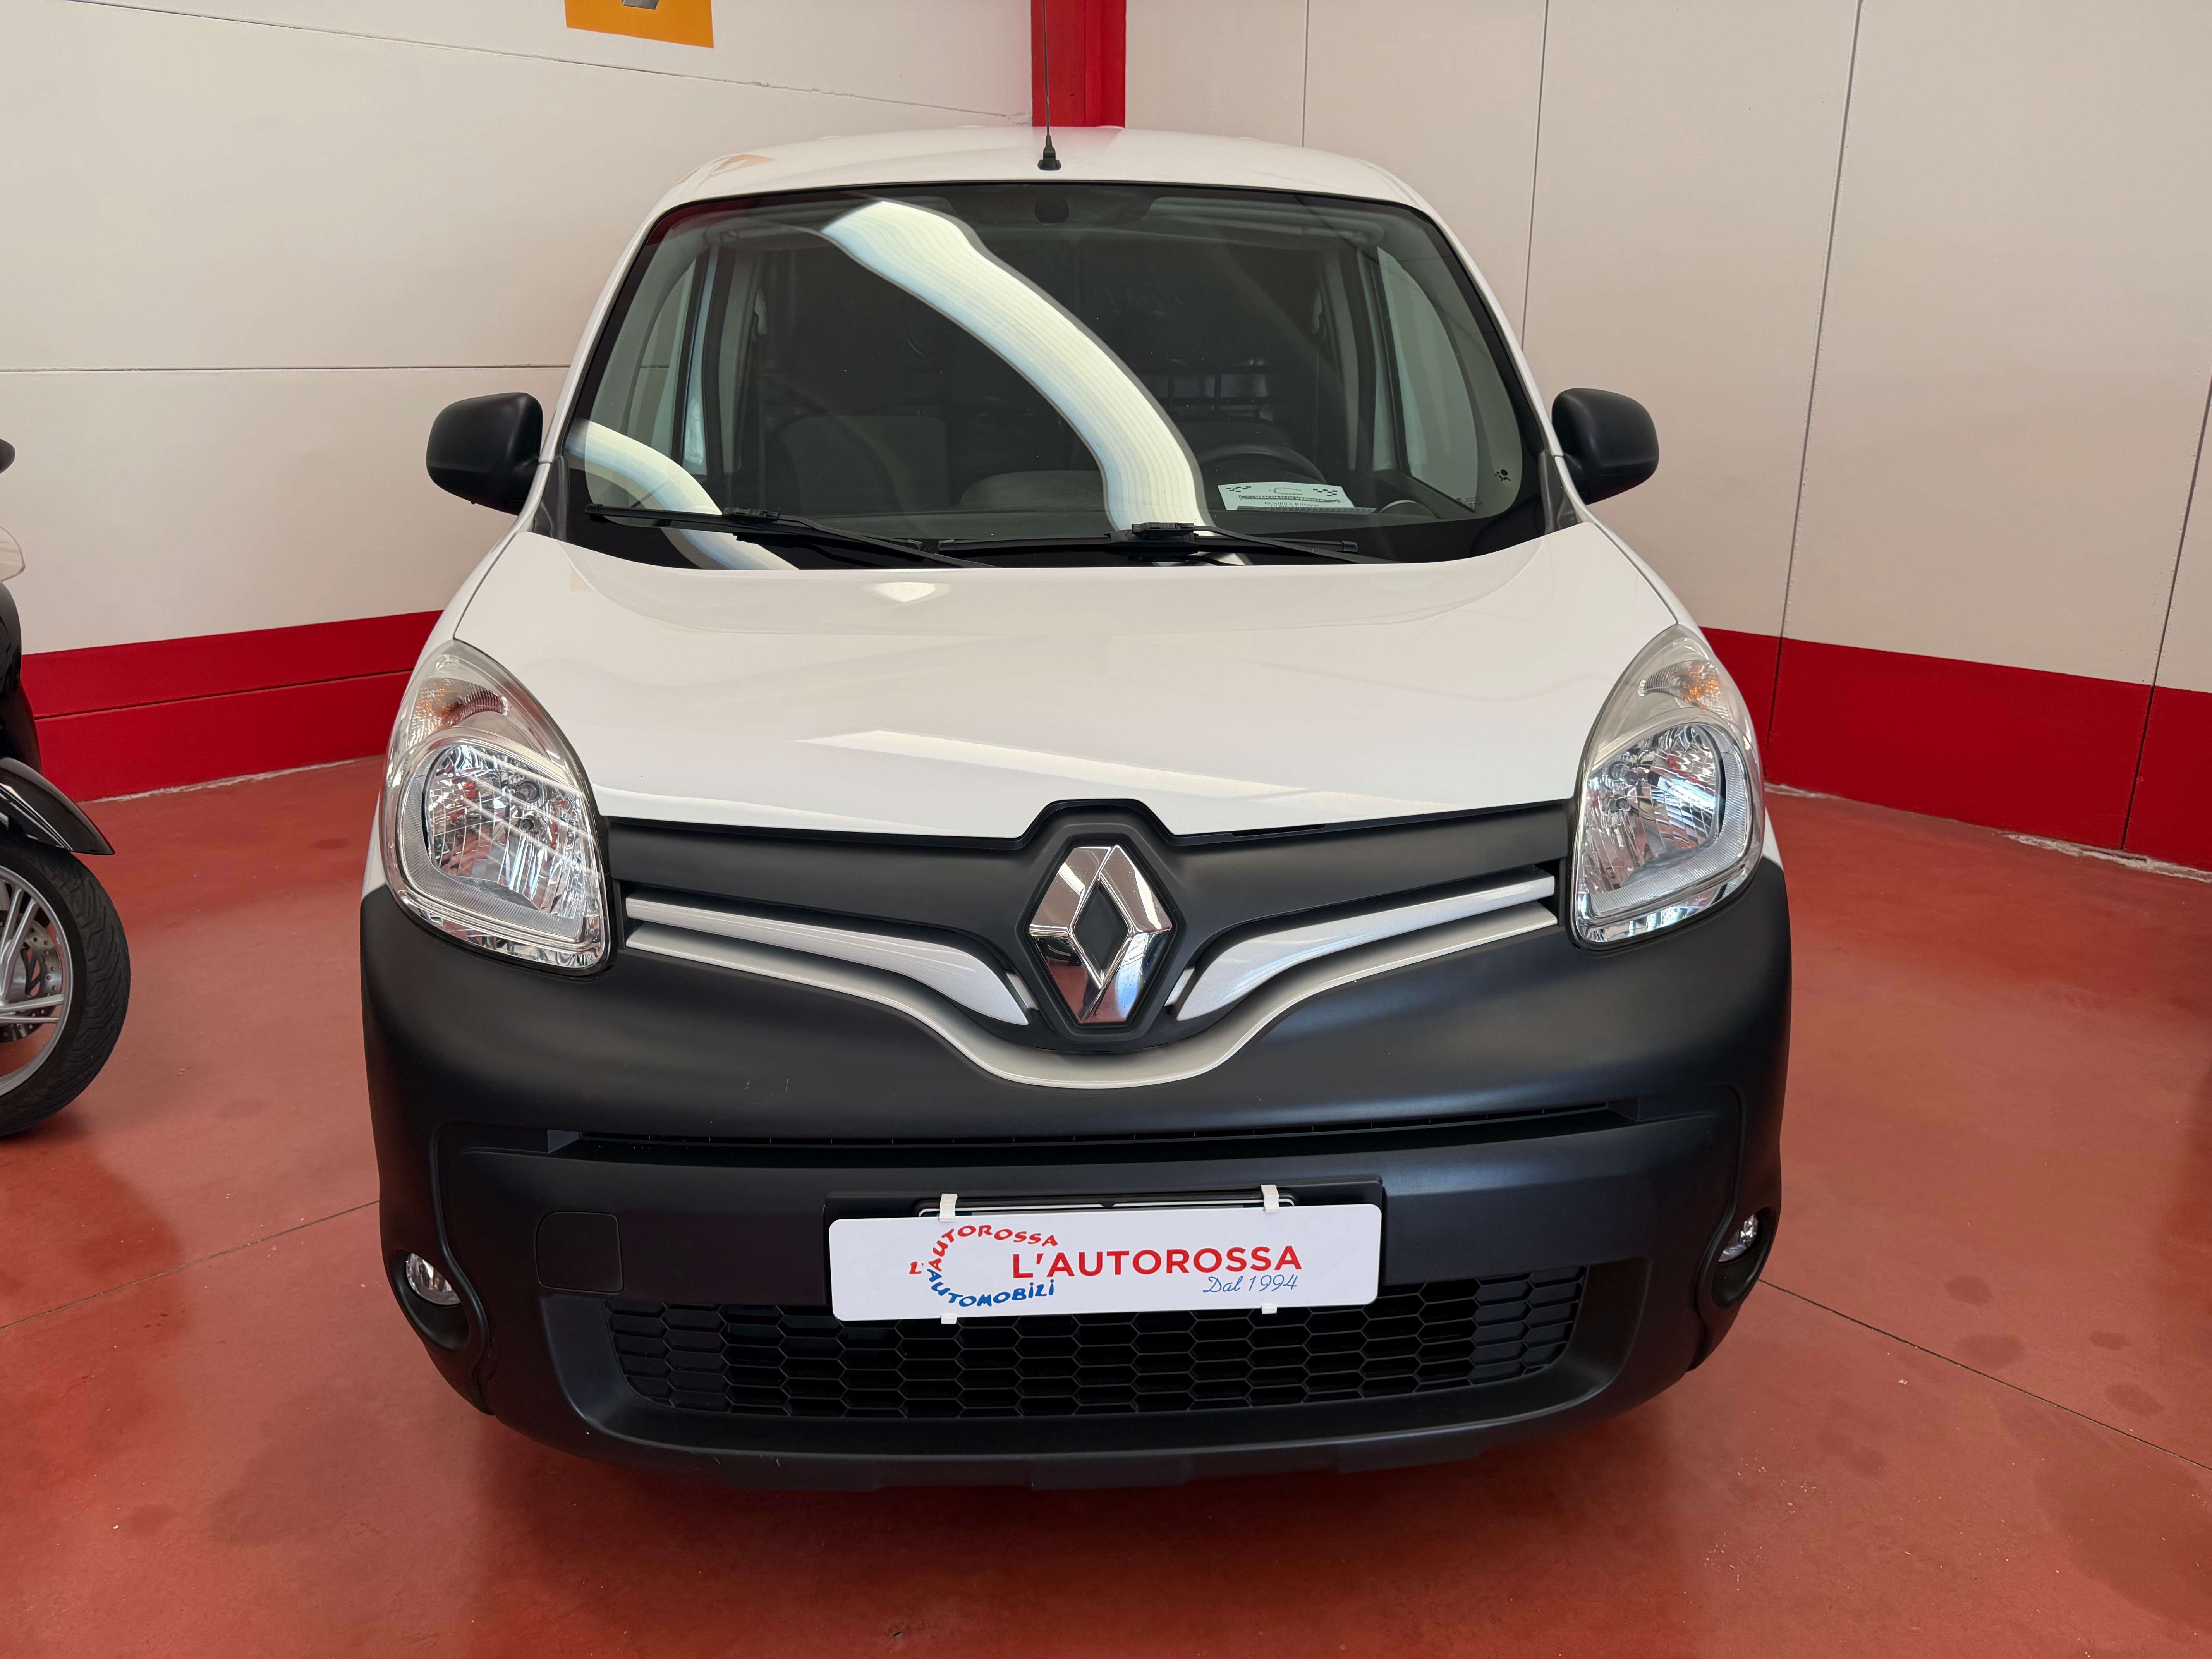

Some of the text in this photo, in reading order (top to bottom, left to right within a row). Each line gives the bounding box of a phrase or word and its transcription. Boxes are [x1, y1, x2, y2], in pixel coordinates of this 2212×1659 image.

[1013, 1246, 1302, 1278] L'AUTOROSSA
[1203, 1274, 1298, 1292] Dal 1994
